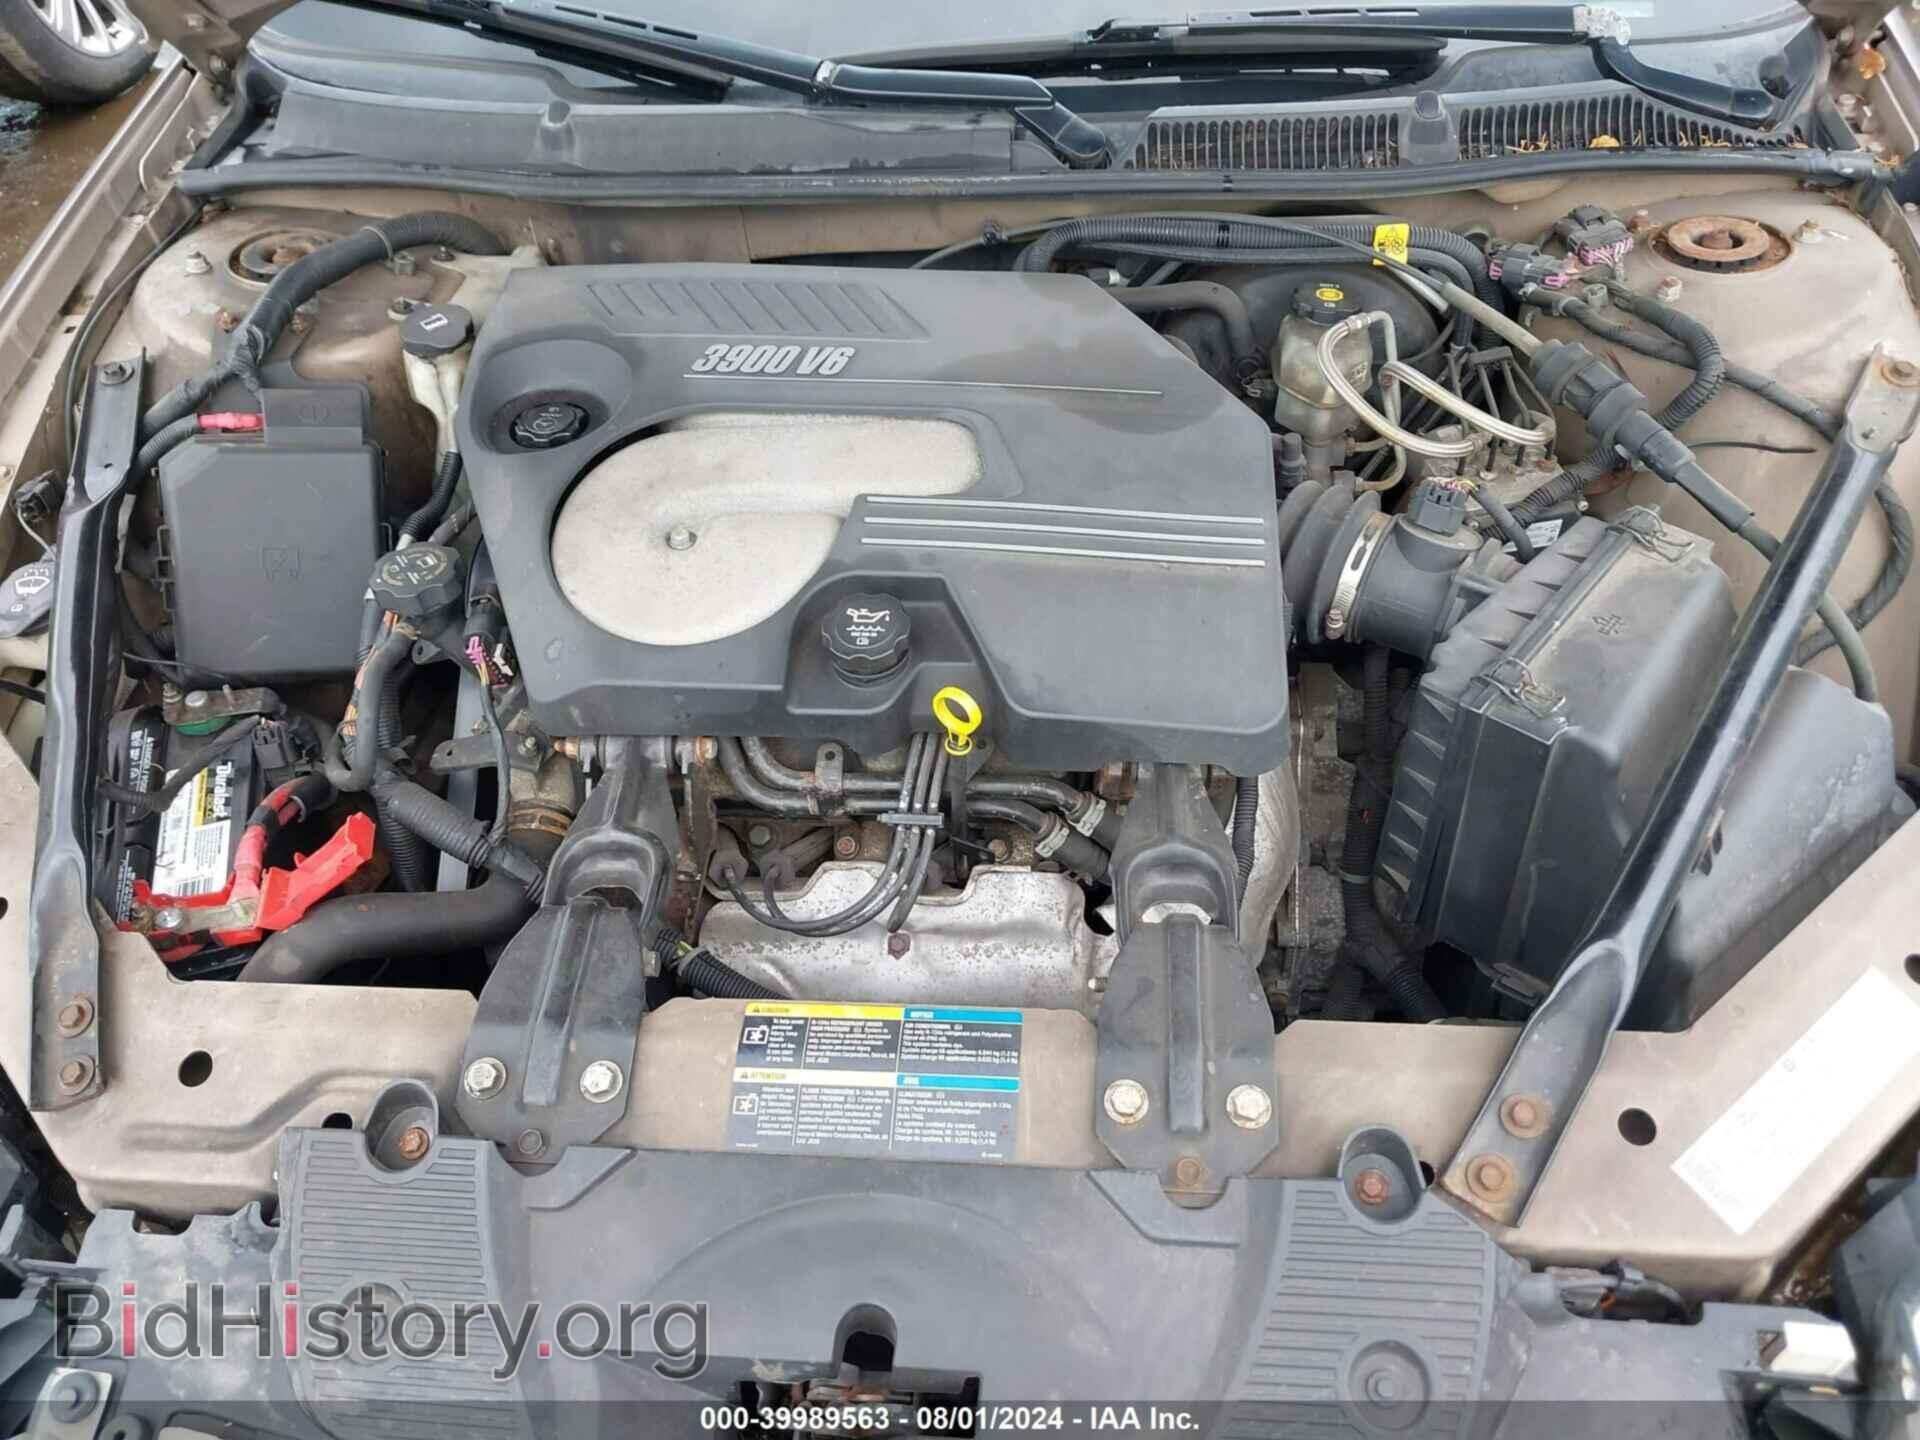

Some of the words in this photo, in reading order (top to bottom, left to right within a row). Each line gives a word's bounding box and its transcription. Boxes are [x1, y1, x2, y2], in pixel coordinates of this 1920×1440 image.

[691, 344, 801, 373] 3900
[796, 346, 856, 375] V6
[213, 764, 231, 818] Duralast
